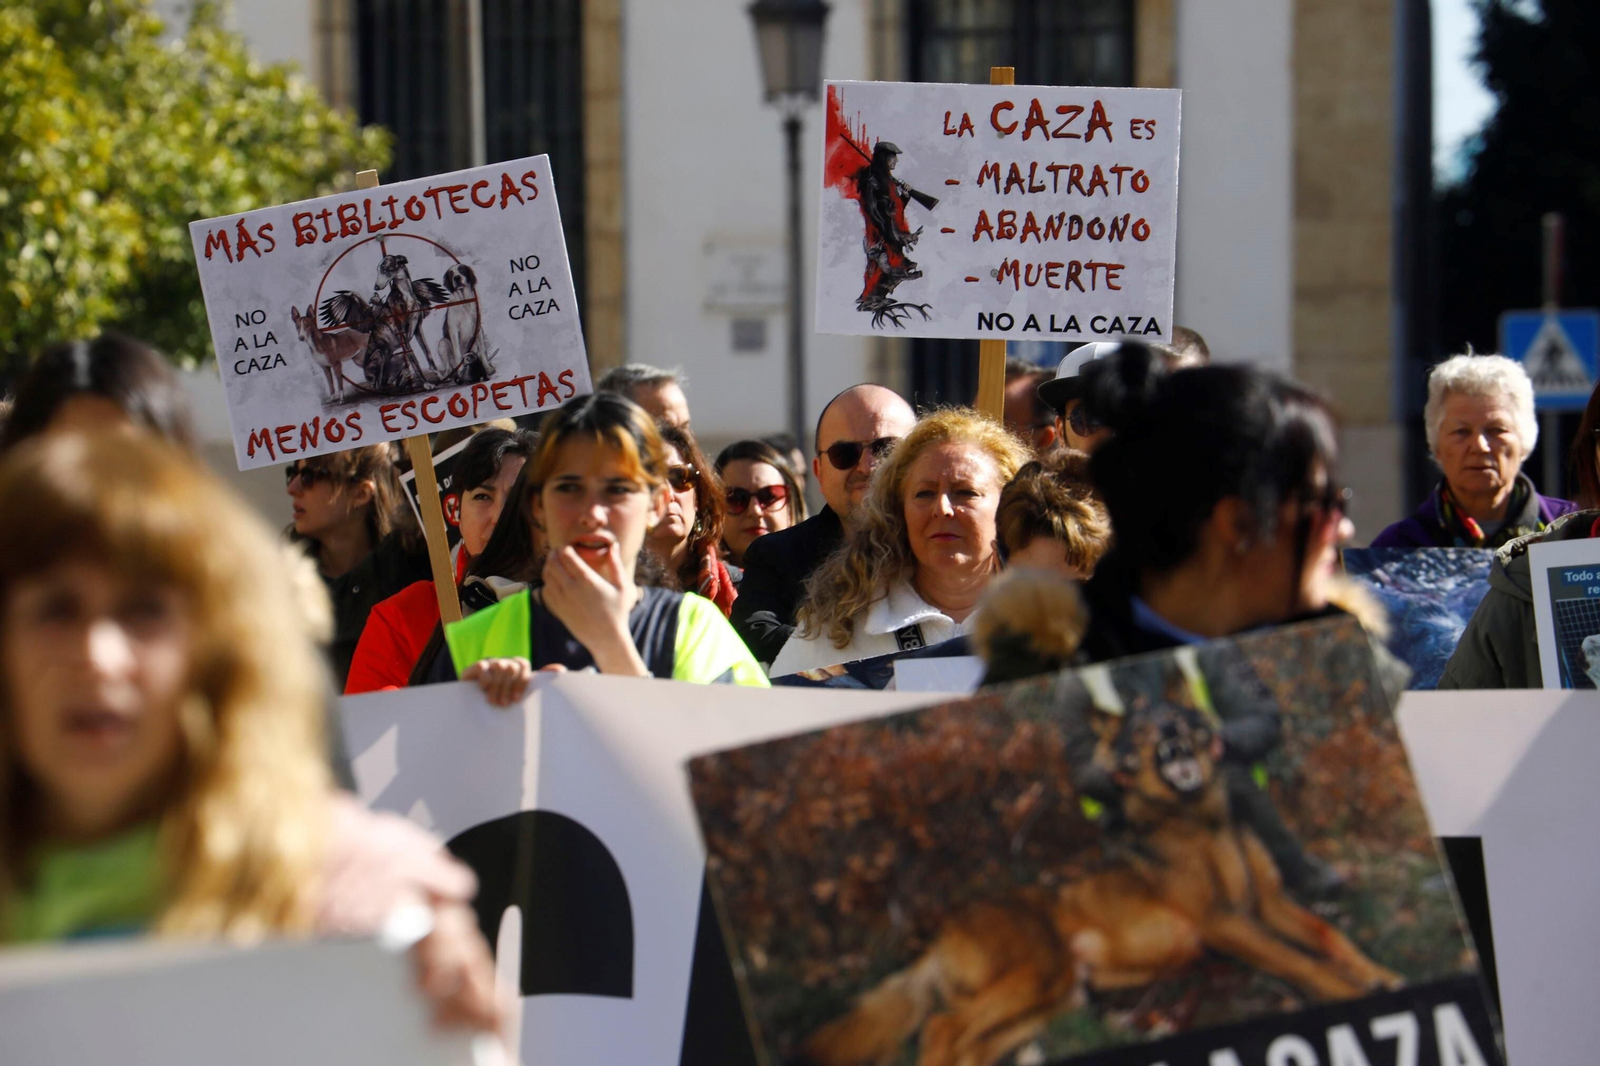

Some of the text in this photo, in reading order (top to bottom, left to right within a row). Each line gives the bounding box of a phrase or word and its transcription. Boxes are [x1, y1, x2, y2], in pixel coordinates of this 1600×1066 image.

[944, 99, 1155, 142] LA CAZA ES
[977, 162, 1149, 197] MALTRATO
[204, 170, 538, 263] MÁS BIBLIOTECAS
[973, 210, 1150, 243] ABANDONO
[510, 255, 540, 273] NO
[998, 258, 1125, 292] MUERTE
[509, 277, 551, 297] A LA
[236, 310, 266, 328] NO
[509, 299, 560, 320] CAZA
[978, 313, 1161, 335] NO A LA CAZA
[235, 332, 278, 352] A LA
[234, 353, 287, 375] CAZA
[247, 369, 576, 460] MENOS ESCOPETAS
[1564, 570, 1594, 582] Todo
